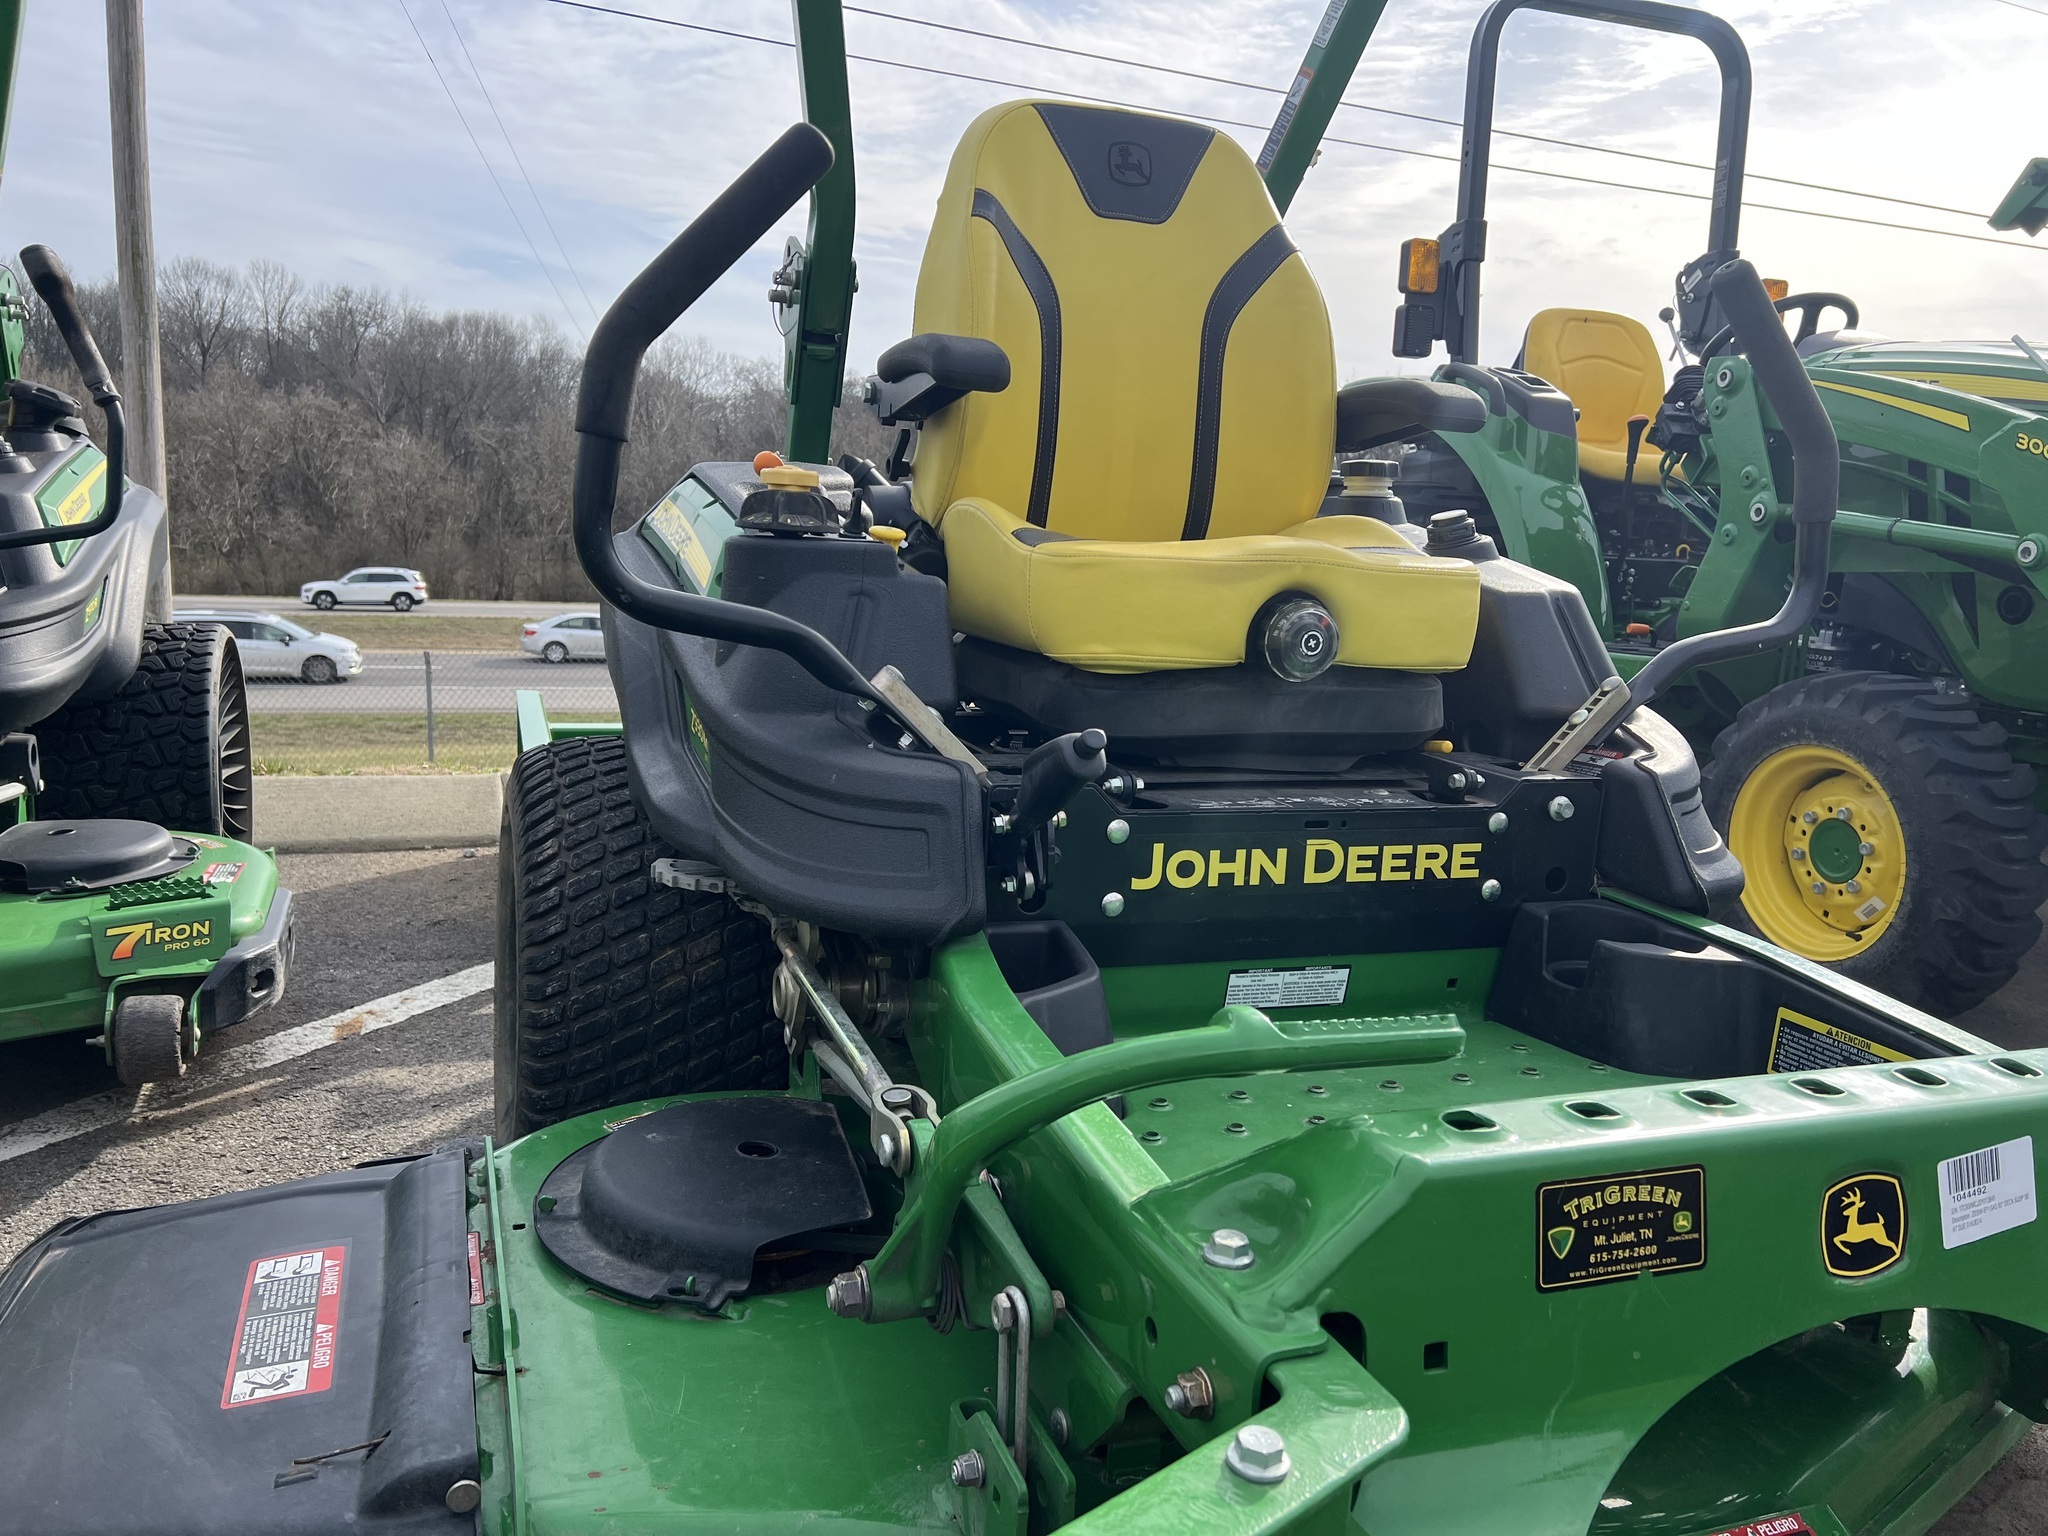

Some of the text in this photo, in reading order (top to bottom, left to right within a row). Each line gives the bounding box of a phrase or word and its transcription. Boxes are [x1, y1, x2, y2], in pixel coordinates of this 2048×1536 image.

[1131, 839, 1483, 890] JOHN DEERE
[164, 937, 211, 952] PRO 60
[1812, 1032, 1833, 1045] AYUDAR
[1838, 1042, 1858, 1053] EVITAR
[1834, 1030, 1871, 1051] ATENCION
[1952, 1186, 1987, 1204] 1044492
[1583, 1210, 1663, 1228] EQUIPMENT
[1594, 1228, 1653, 1247] Mt. Juliet, TN
[1589, 1245, 1658, 1264] 615-754-2600
[1569, 1256, 1678, 1278] www.TriGreenEquipment.com
[321, 1266, 340, 1297] DANGER
[312, 1328, 334, 1370] PELIGRO
[1757, 1517, 1799, 1536] PELIGRO
